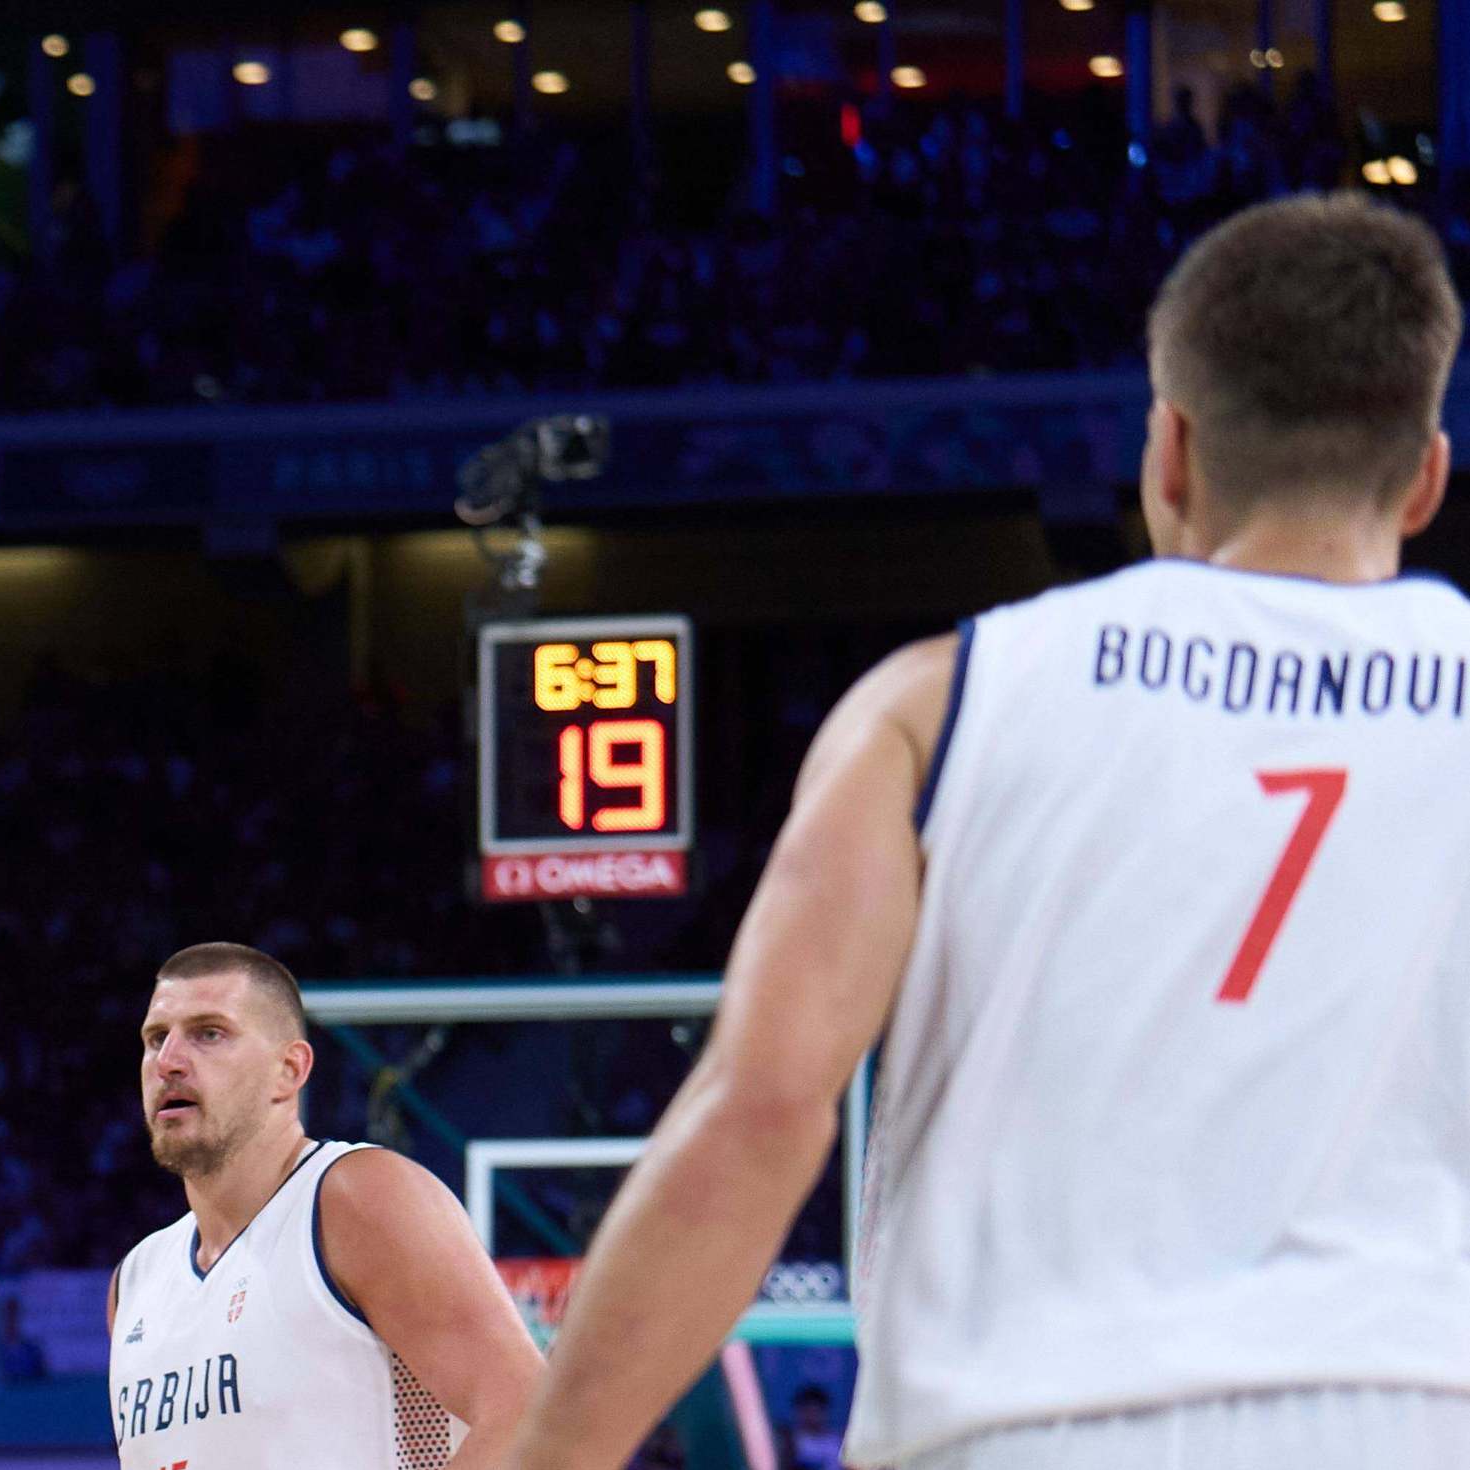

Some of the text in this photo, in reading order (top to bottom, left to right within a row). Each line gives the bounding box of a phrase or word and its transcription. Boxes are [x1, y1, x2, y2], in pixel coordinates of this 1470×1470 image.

[534, 640, 676, 711] 6:37
[559, 719, 665, 832] 19
[536, 856, 678, 893] OMEGA
[1216, 766, 1349, 1004] 7
[117, 1353, 241, 1449] SRBIJA
